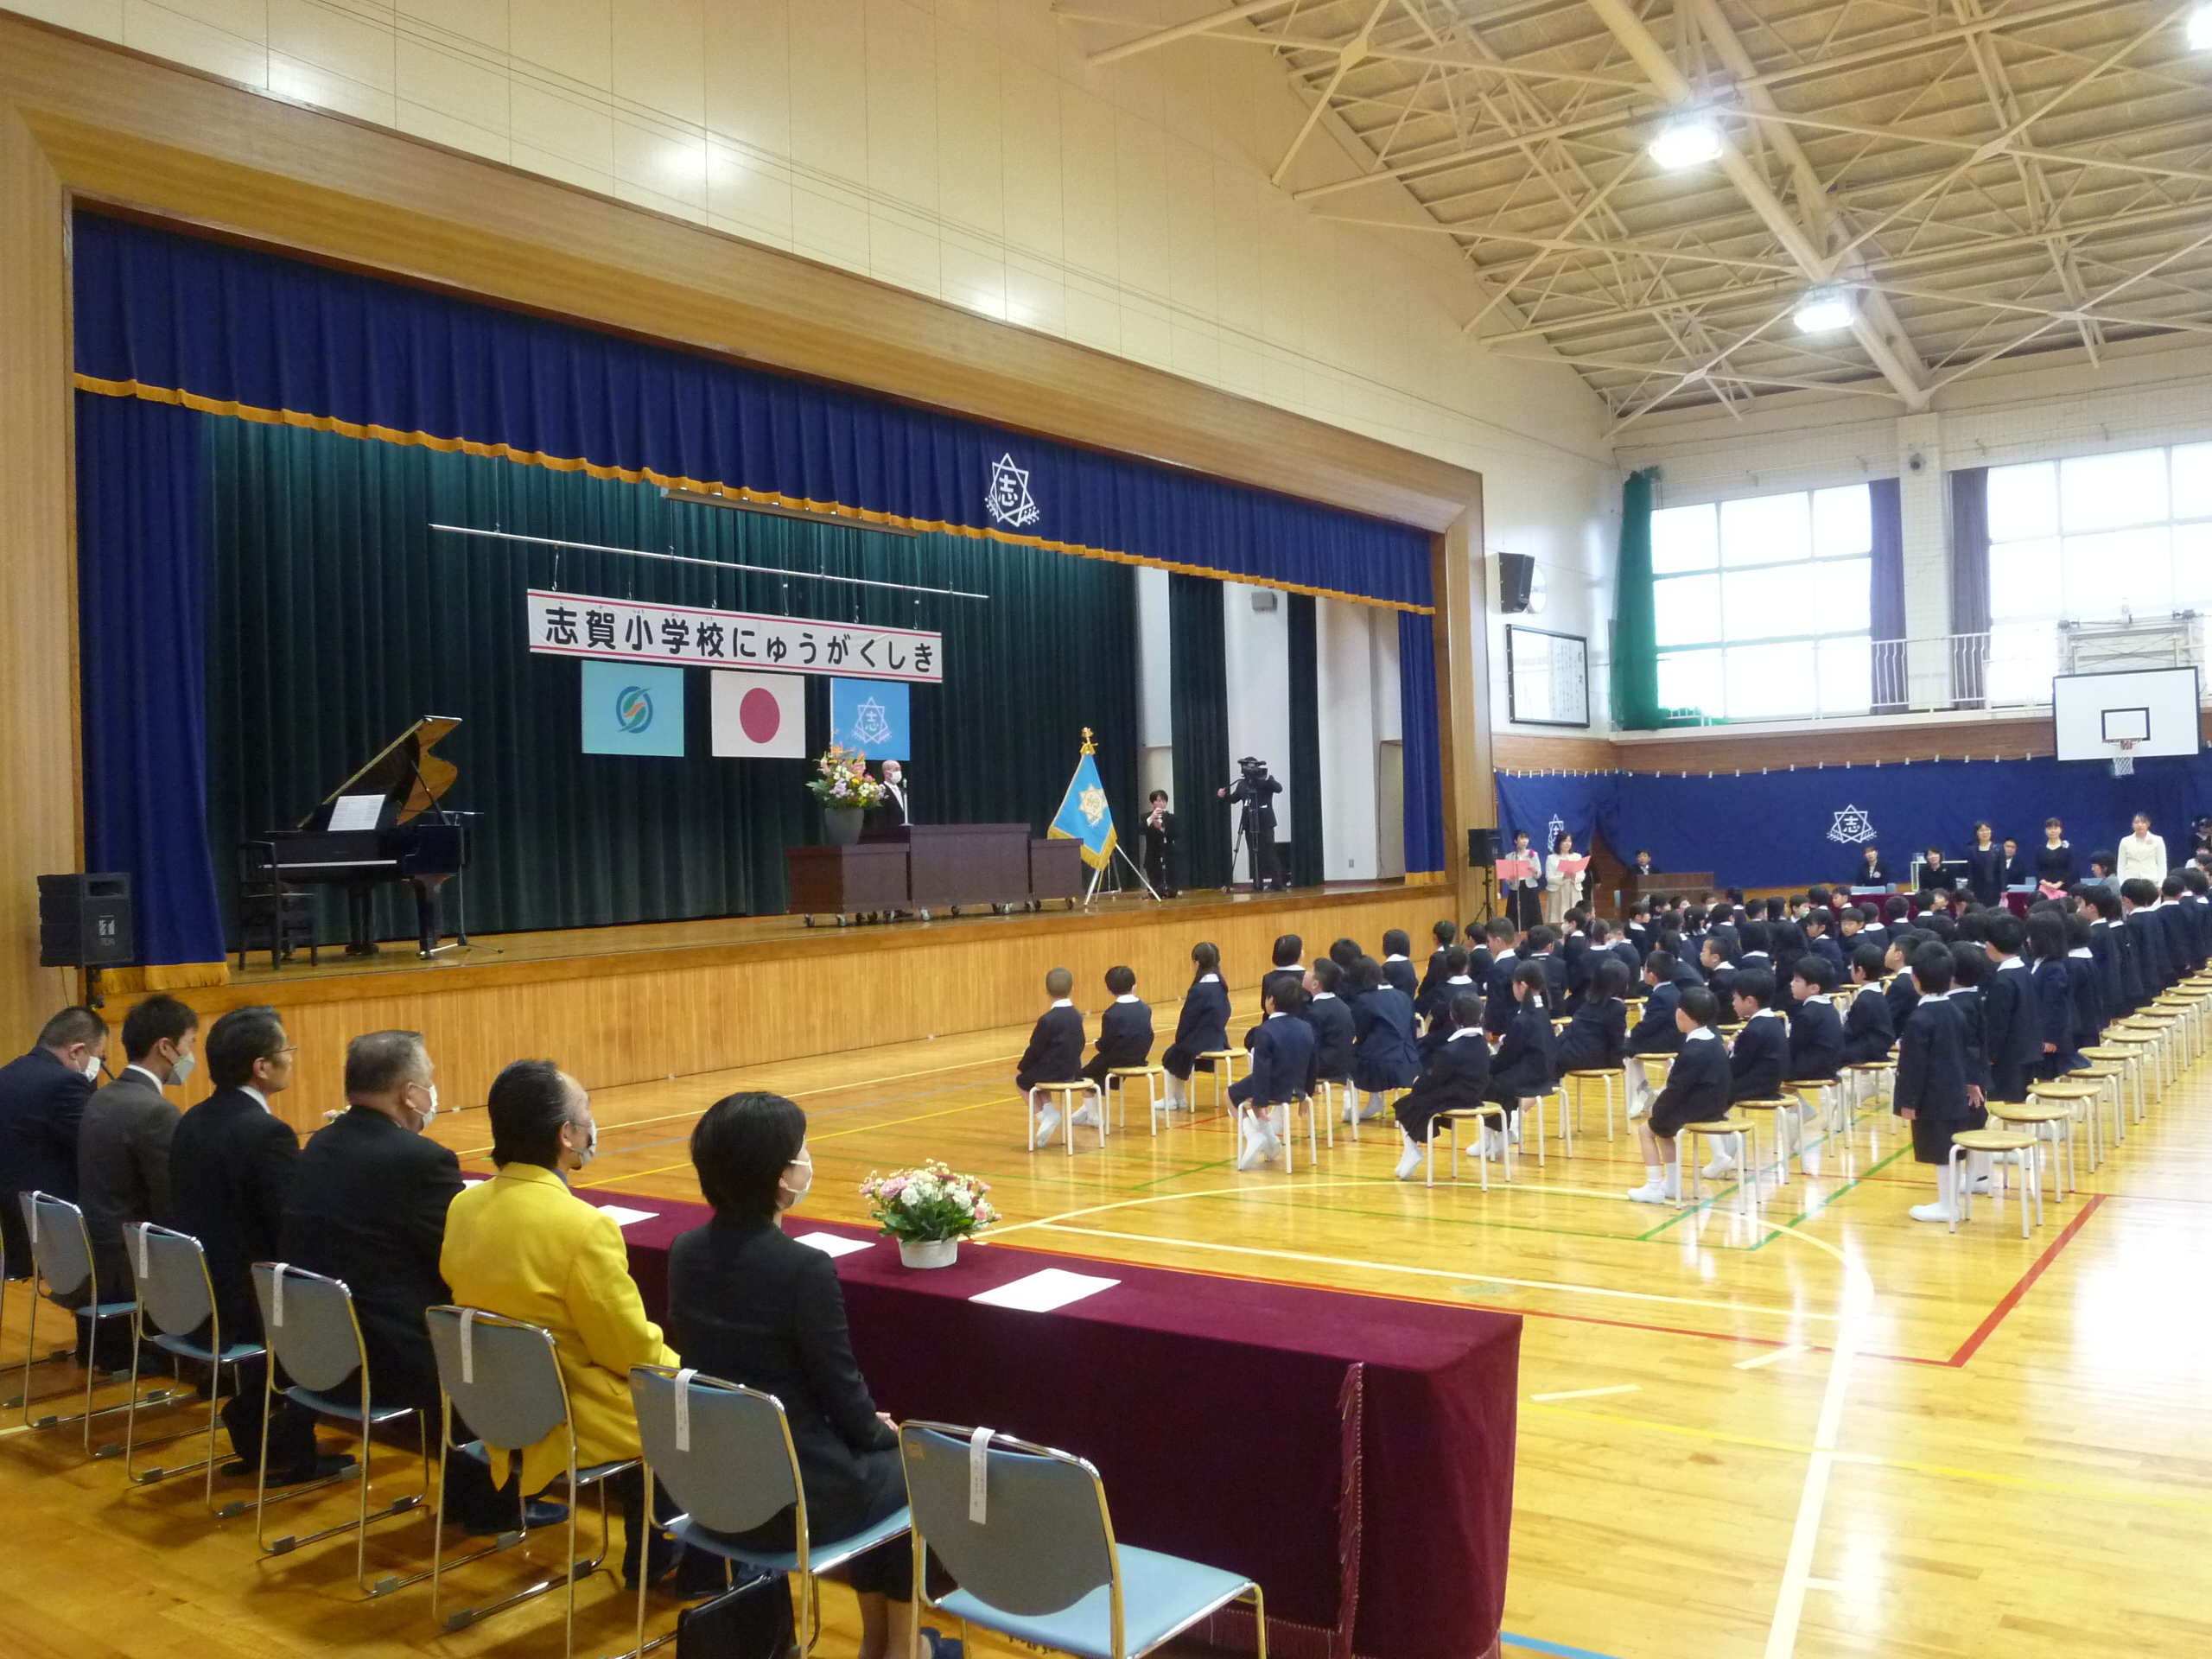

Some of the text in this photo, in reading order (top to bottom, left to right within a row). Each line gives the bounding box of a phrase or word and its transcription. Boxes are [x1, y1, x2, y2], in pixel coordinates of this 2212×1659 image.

[998, 474, 1019, 507] 志
[545, 606, 933, 673] 志賀小学校にゅうがくしき
[865, 710, 880, 732] 志
[1842, 815, 1861, 834] 志
